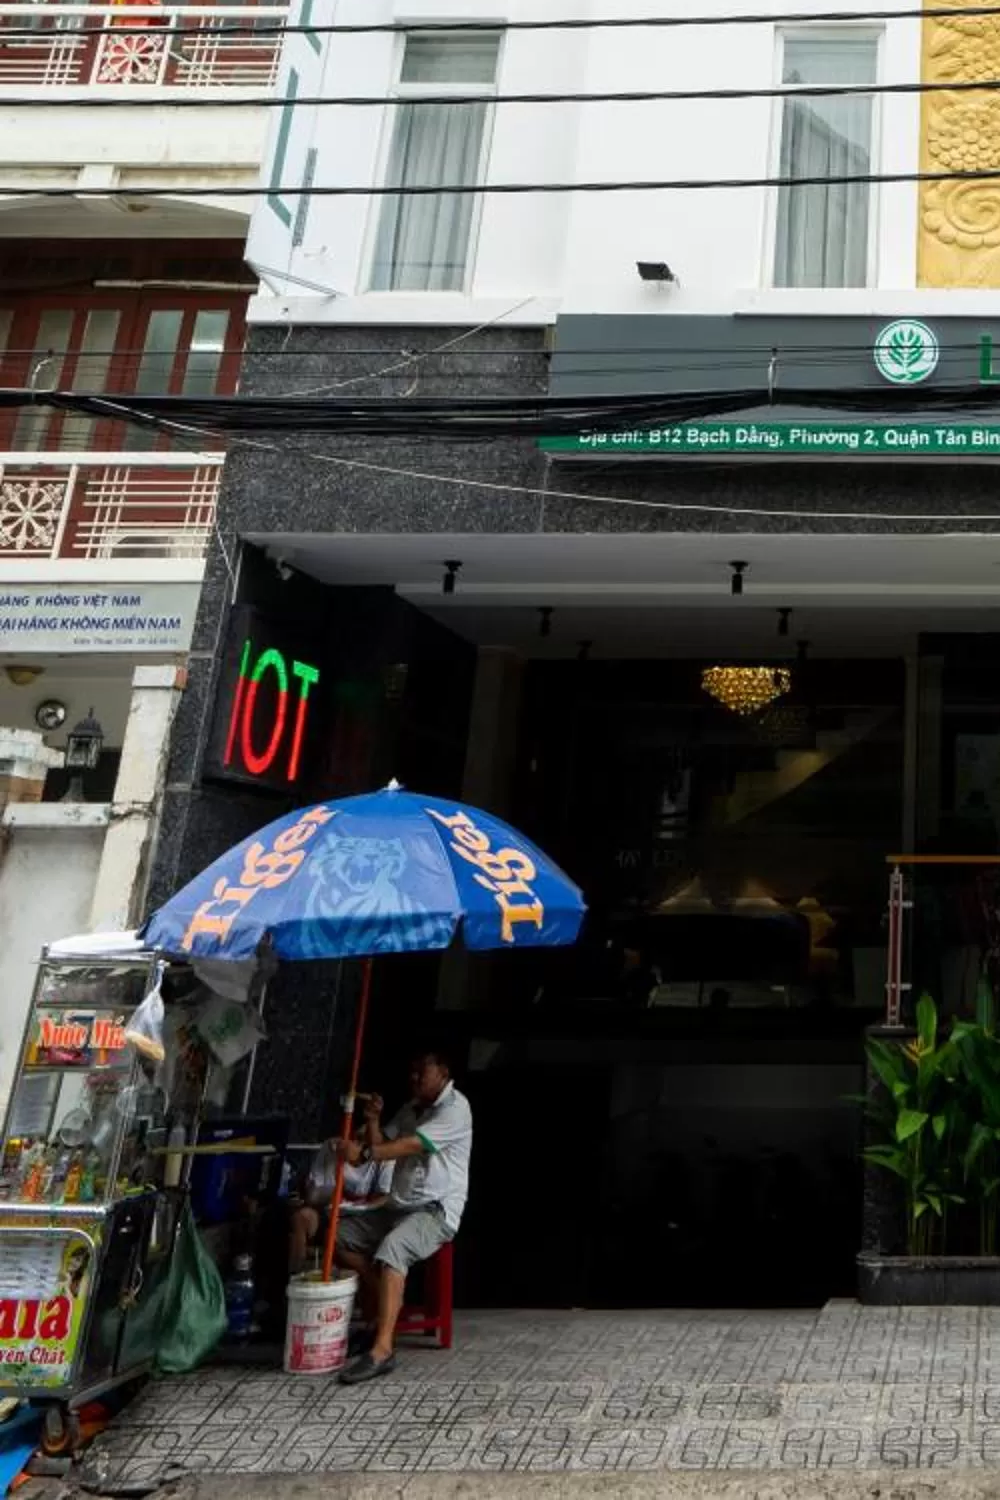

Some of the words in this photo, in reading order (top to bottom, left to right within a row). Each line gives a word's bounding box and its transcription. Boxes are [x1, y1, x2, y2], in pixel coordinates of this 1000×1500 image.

[648, 428, 682, 444] B12
[686, 427, 731, 448] Bạch
[863, 429, 879, 446] 2,
[884, 428, 930, 449] Quận
[936, 428, 967, 446] Tân
[35, 592, 81, 607] KHÔNG
[83, 592, 109, 609] VIỆT
[111, 595, 142, 607] NAM
[59, 614, 111, 630] KHÔNG
[147, 617, 182, 630] NAM
[181, 805, 341, 952] Tiger
[425, 807, 546, 945] Tiger
